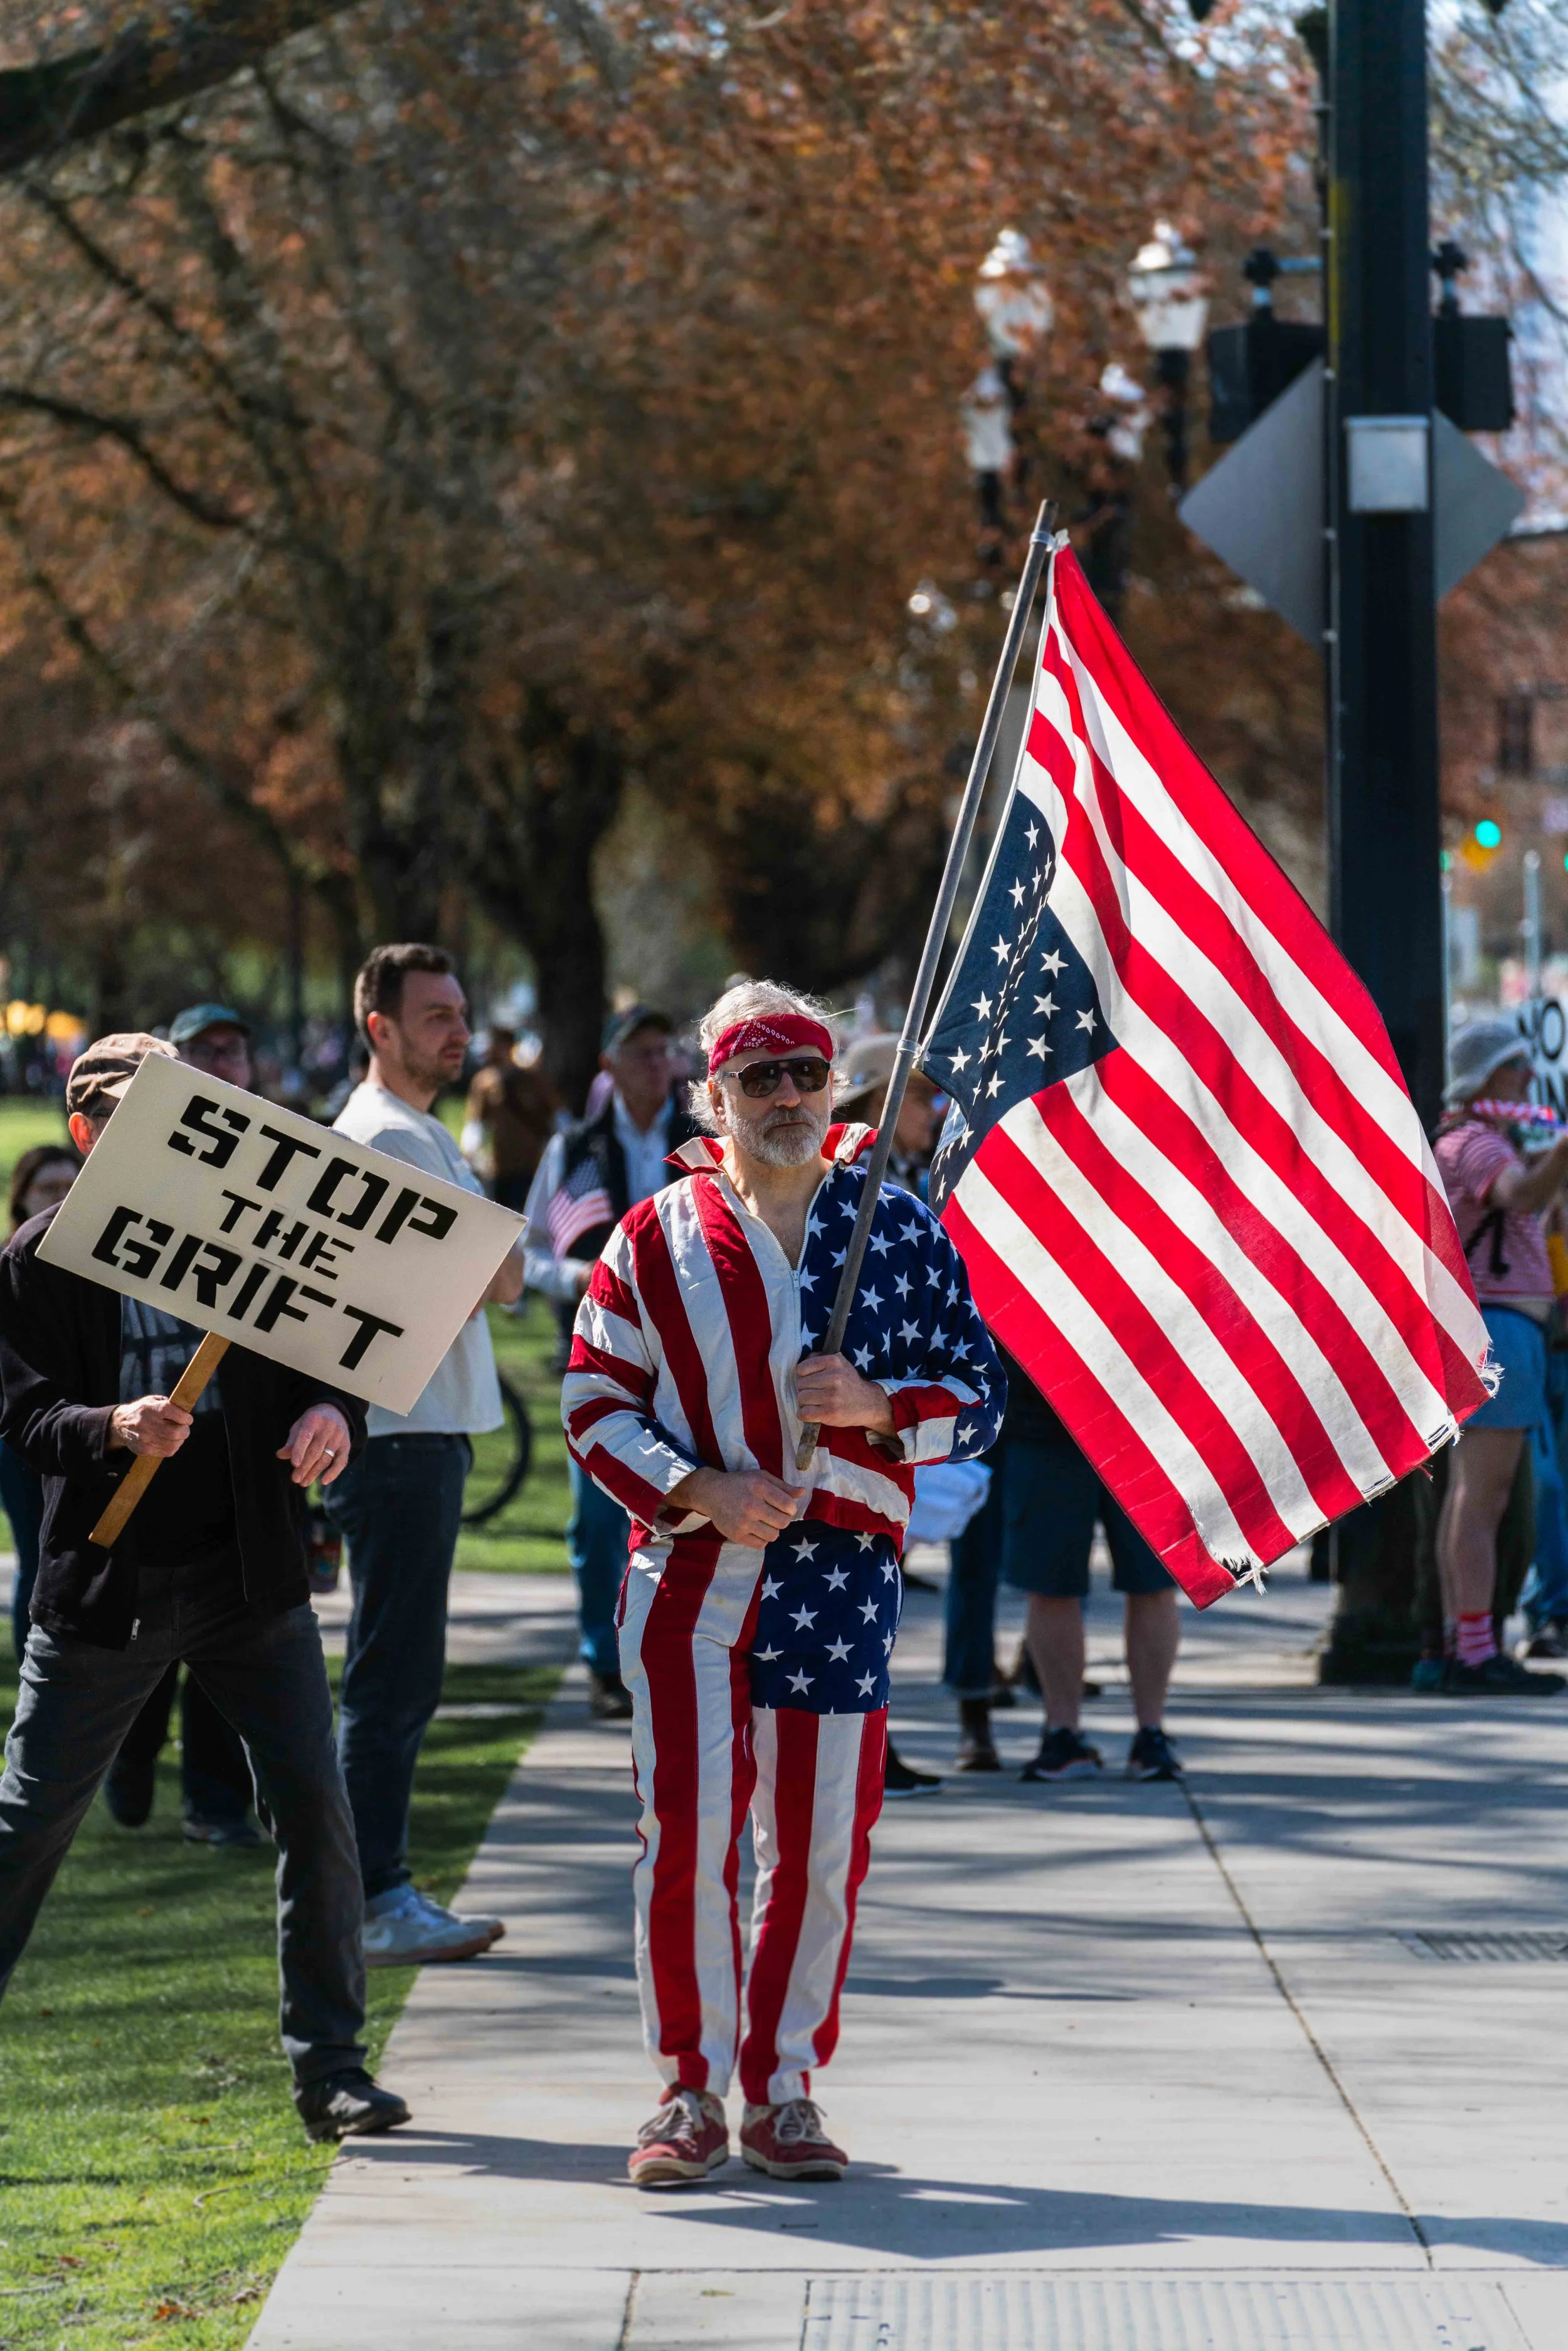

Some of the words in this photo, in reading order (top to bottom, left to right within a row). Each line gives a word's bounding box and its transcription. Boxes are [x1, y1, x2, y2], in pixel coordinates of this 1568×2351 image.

[167, 1095, 458, 1245] STOP
[219, 1189, 356, 1280] THE
[91, 1206, 405, 1371] GRIFT
